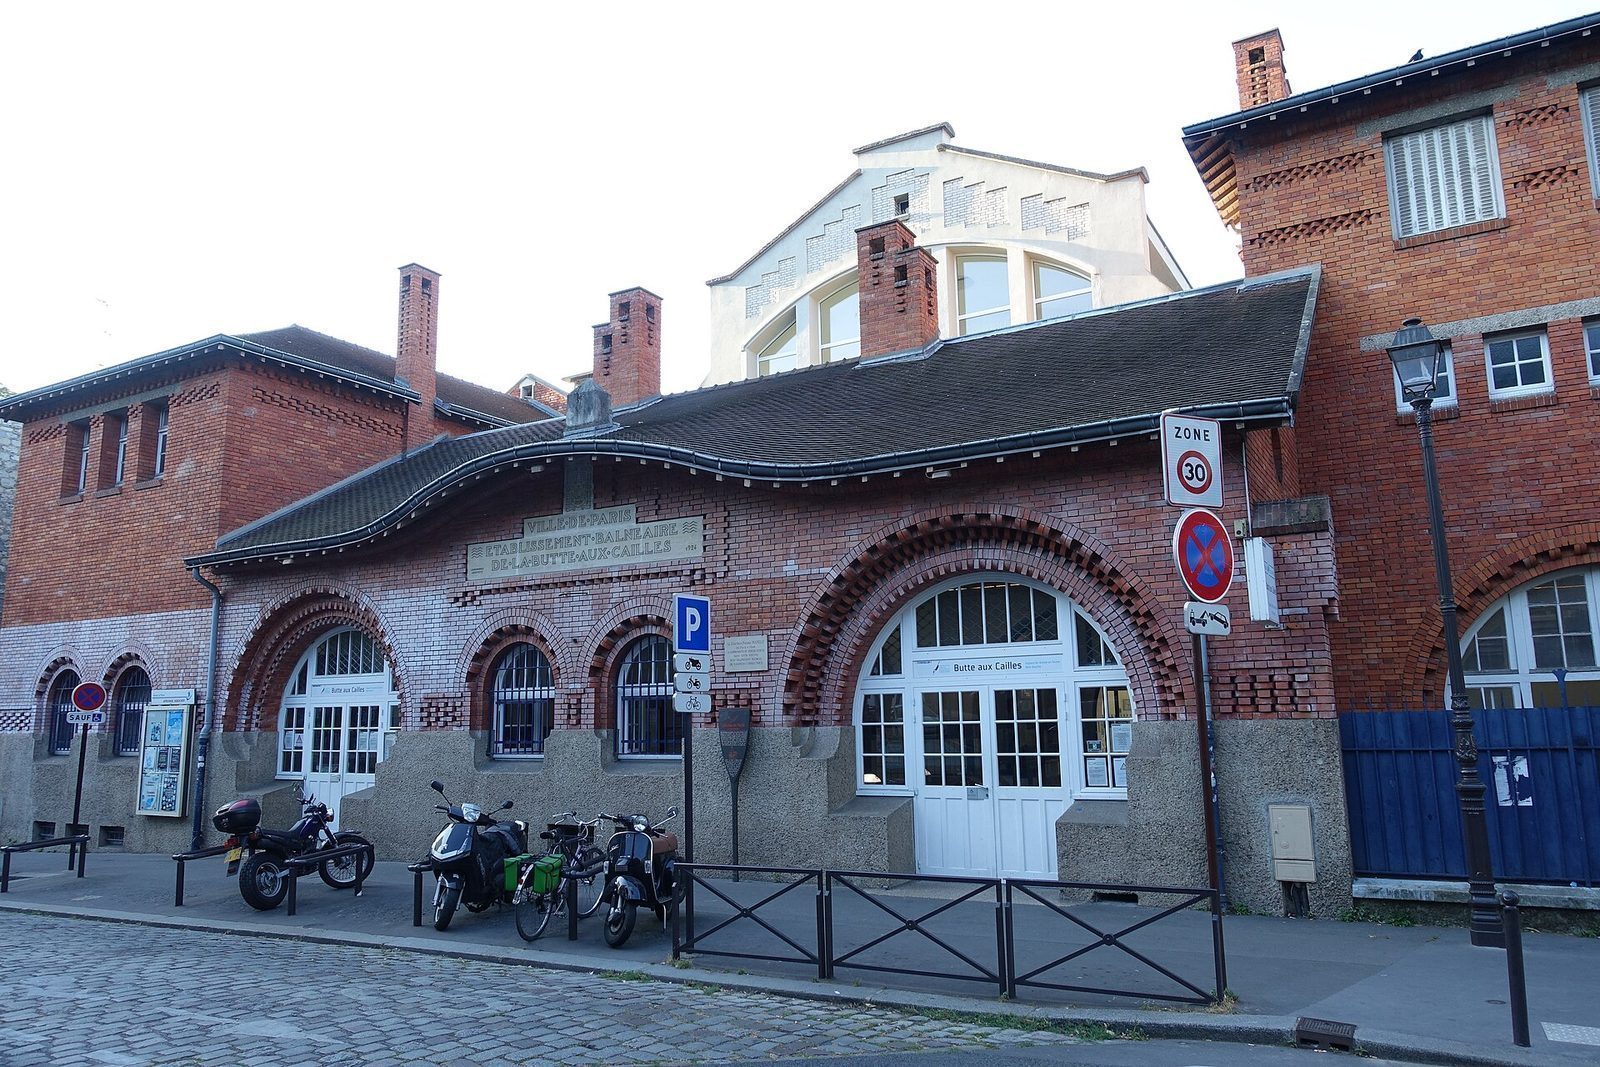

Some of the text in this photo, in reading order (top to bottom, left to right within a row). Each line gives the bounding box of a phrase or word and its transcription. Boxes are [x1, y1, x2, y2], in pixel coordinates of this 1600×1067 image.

[1174, 427, 1210, 441] ZONE
[1184, 462, 1206, 482] 30
[686, 607, 701, 641] P
[953, 663, 975, 672] Butte
[978, 663, 993, 671] aux
[995, 661, 1022, 671] Cailles
